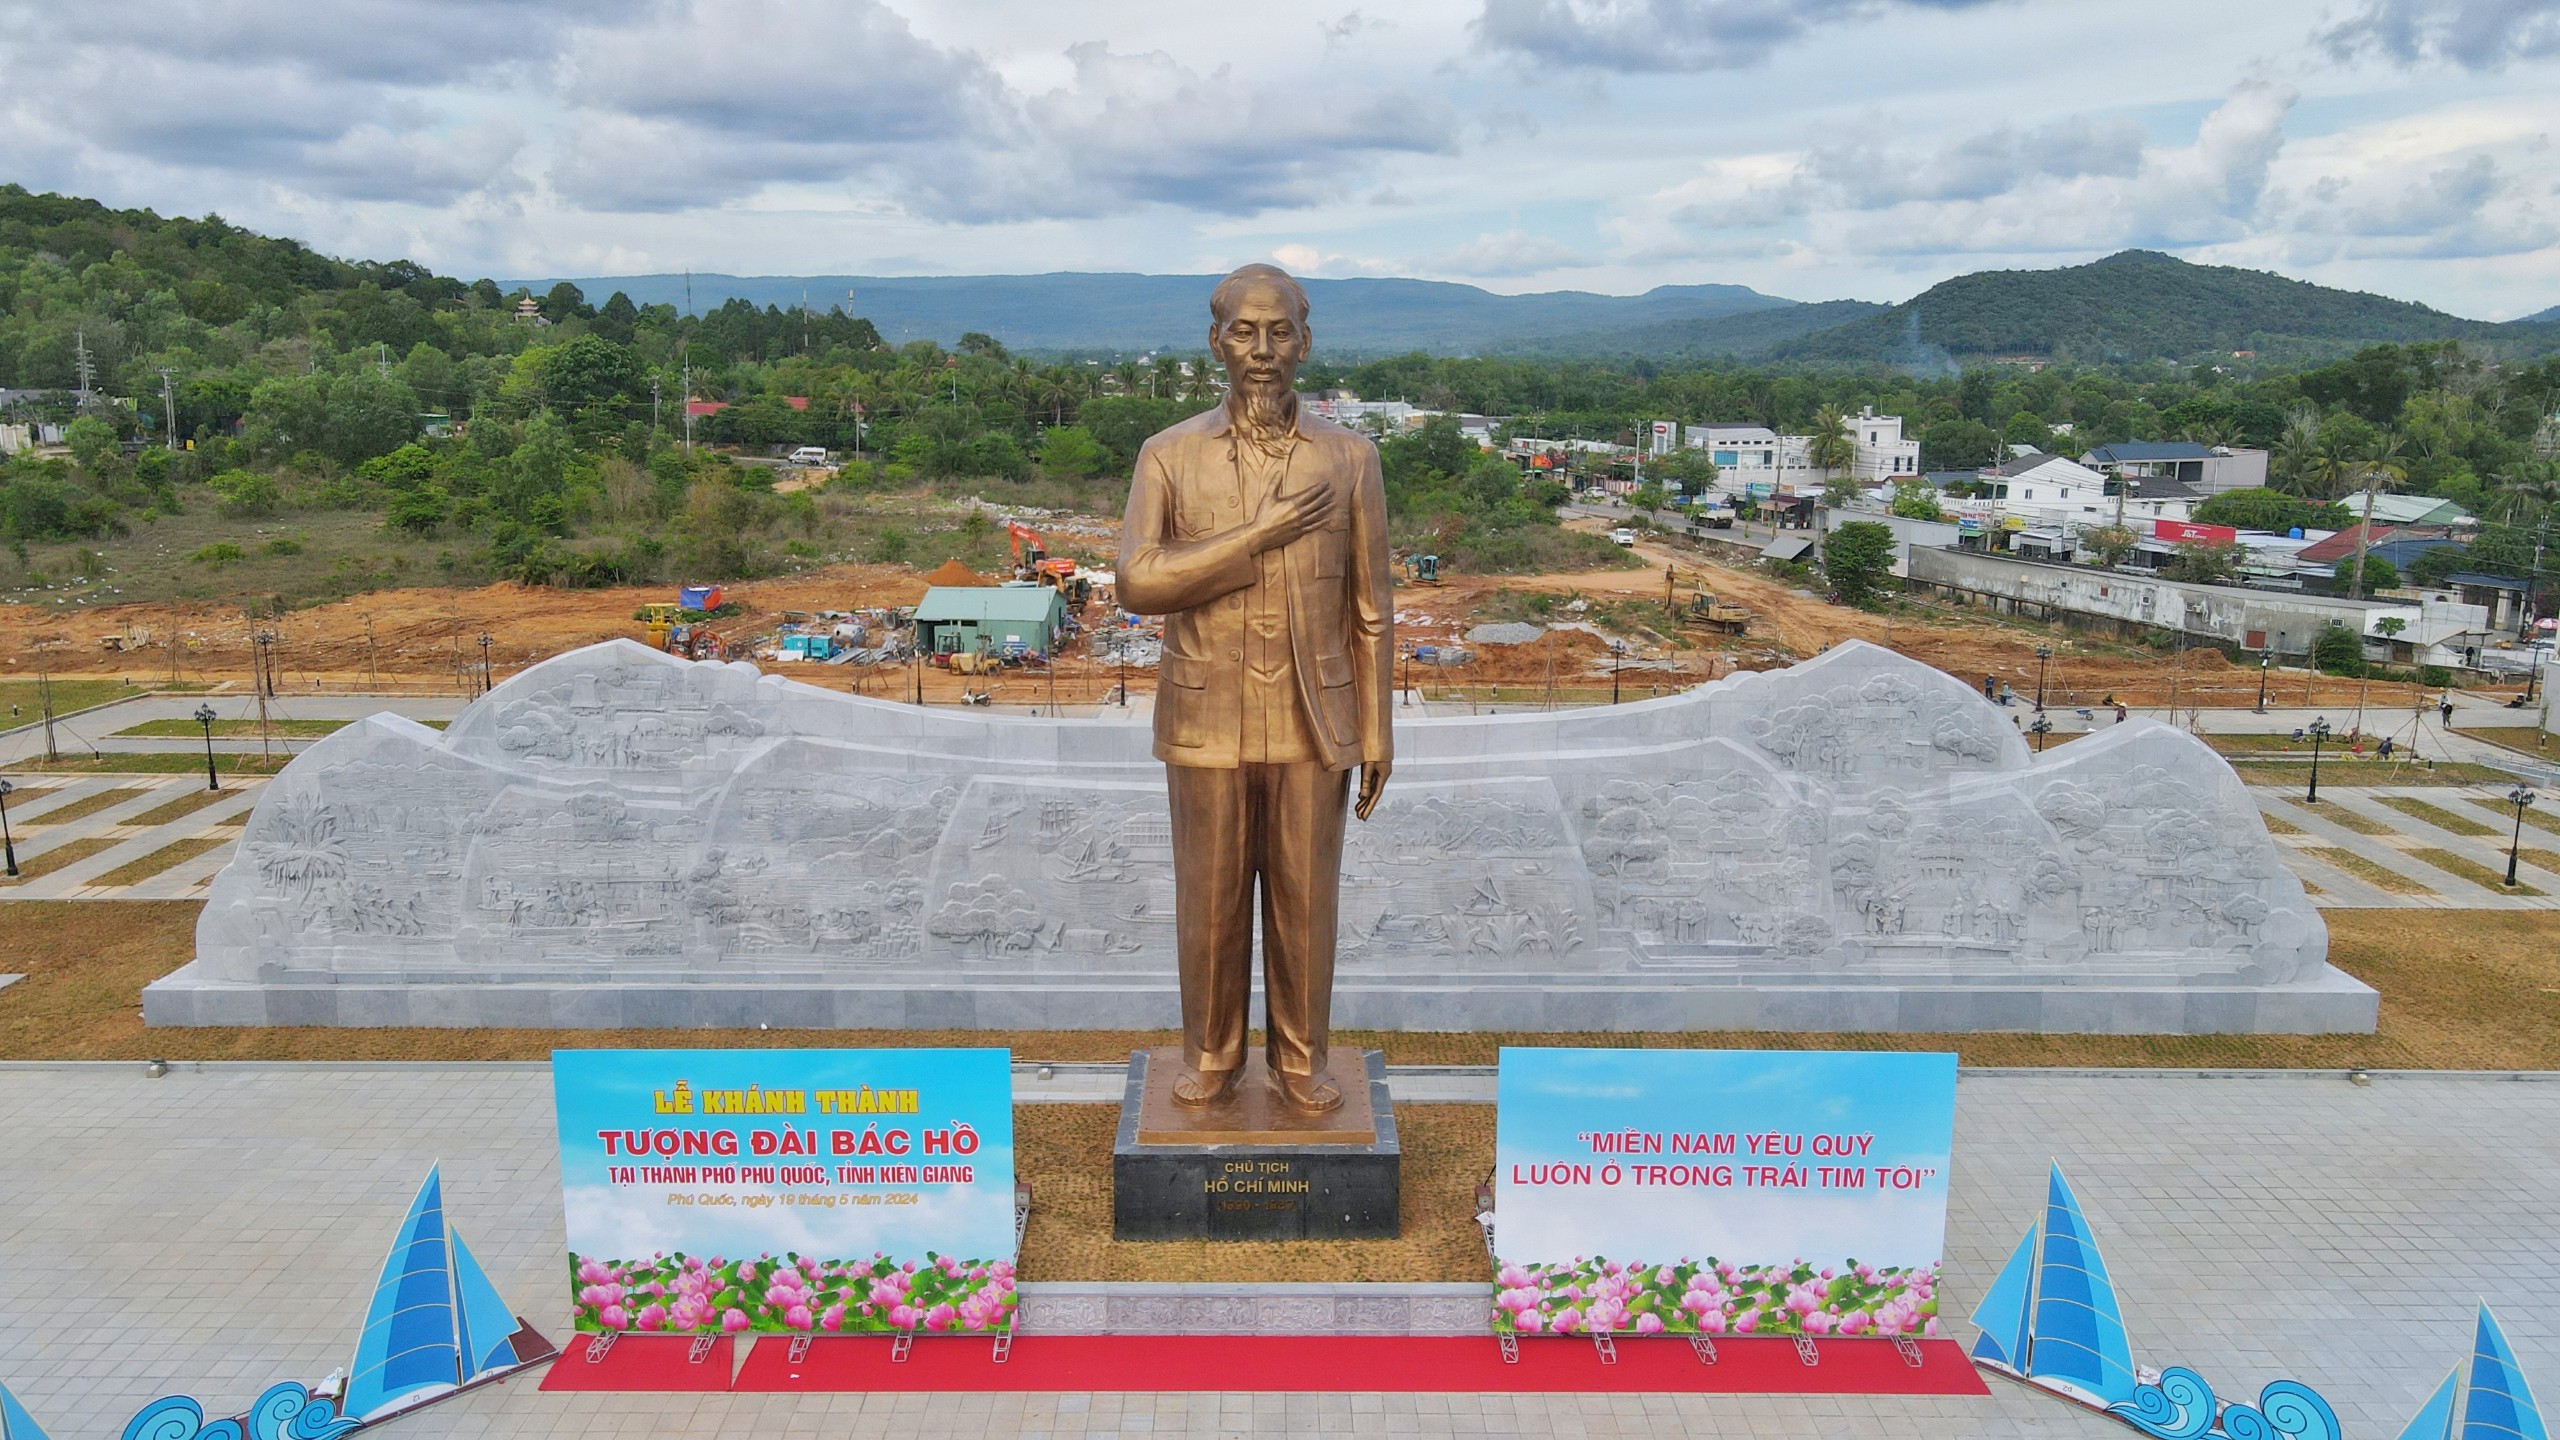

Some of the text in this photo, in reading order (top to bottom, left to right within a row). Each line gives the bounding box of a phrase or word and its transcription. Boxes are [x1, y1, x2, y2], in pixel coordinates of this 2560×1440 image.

[654, 1080, 919, 1114] LỄ KHÁNH THÀNH
[598, 1120, 980, 1160] TƯỢNG ĐÀI BÁC HỒ
[1671, 1133, 1735, 1155] NAM
[1745, 1131, 1803, 1156] YÊU
[1811, 1131, 1876, 1157] QUÝ
[608, 1161, 974, 1187] TẠI THÀNH PHỐ PHÚ QUỐC, TỈNH KIÊN GIANG
[1224, 1160, 1289, 1174] CHỦ TỊCH
[1512, 1160, 1591, 1185] LUÔN
[1600, 1158, 1622, 1186] Ở
[1631, 1165, 1733, 1187] TRONG
[1742, 1162, 1808, 1188] TRÁI
[1816, 1167, 1865, 1188] TIM
[1204, 1175, 1309, 1193] HỒ CHÍ MINH
[667, 1192, 919, 1208] Phú Quốc, ngày 19 tháng 5 năm 2024
